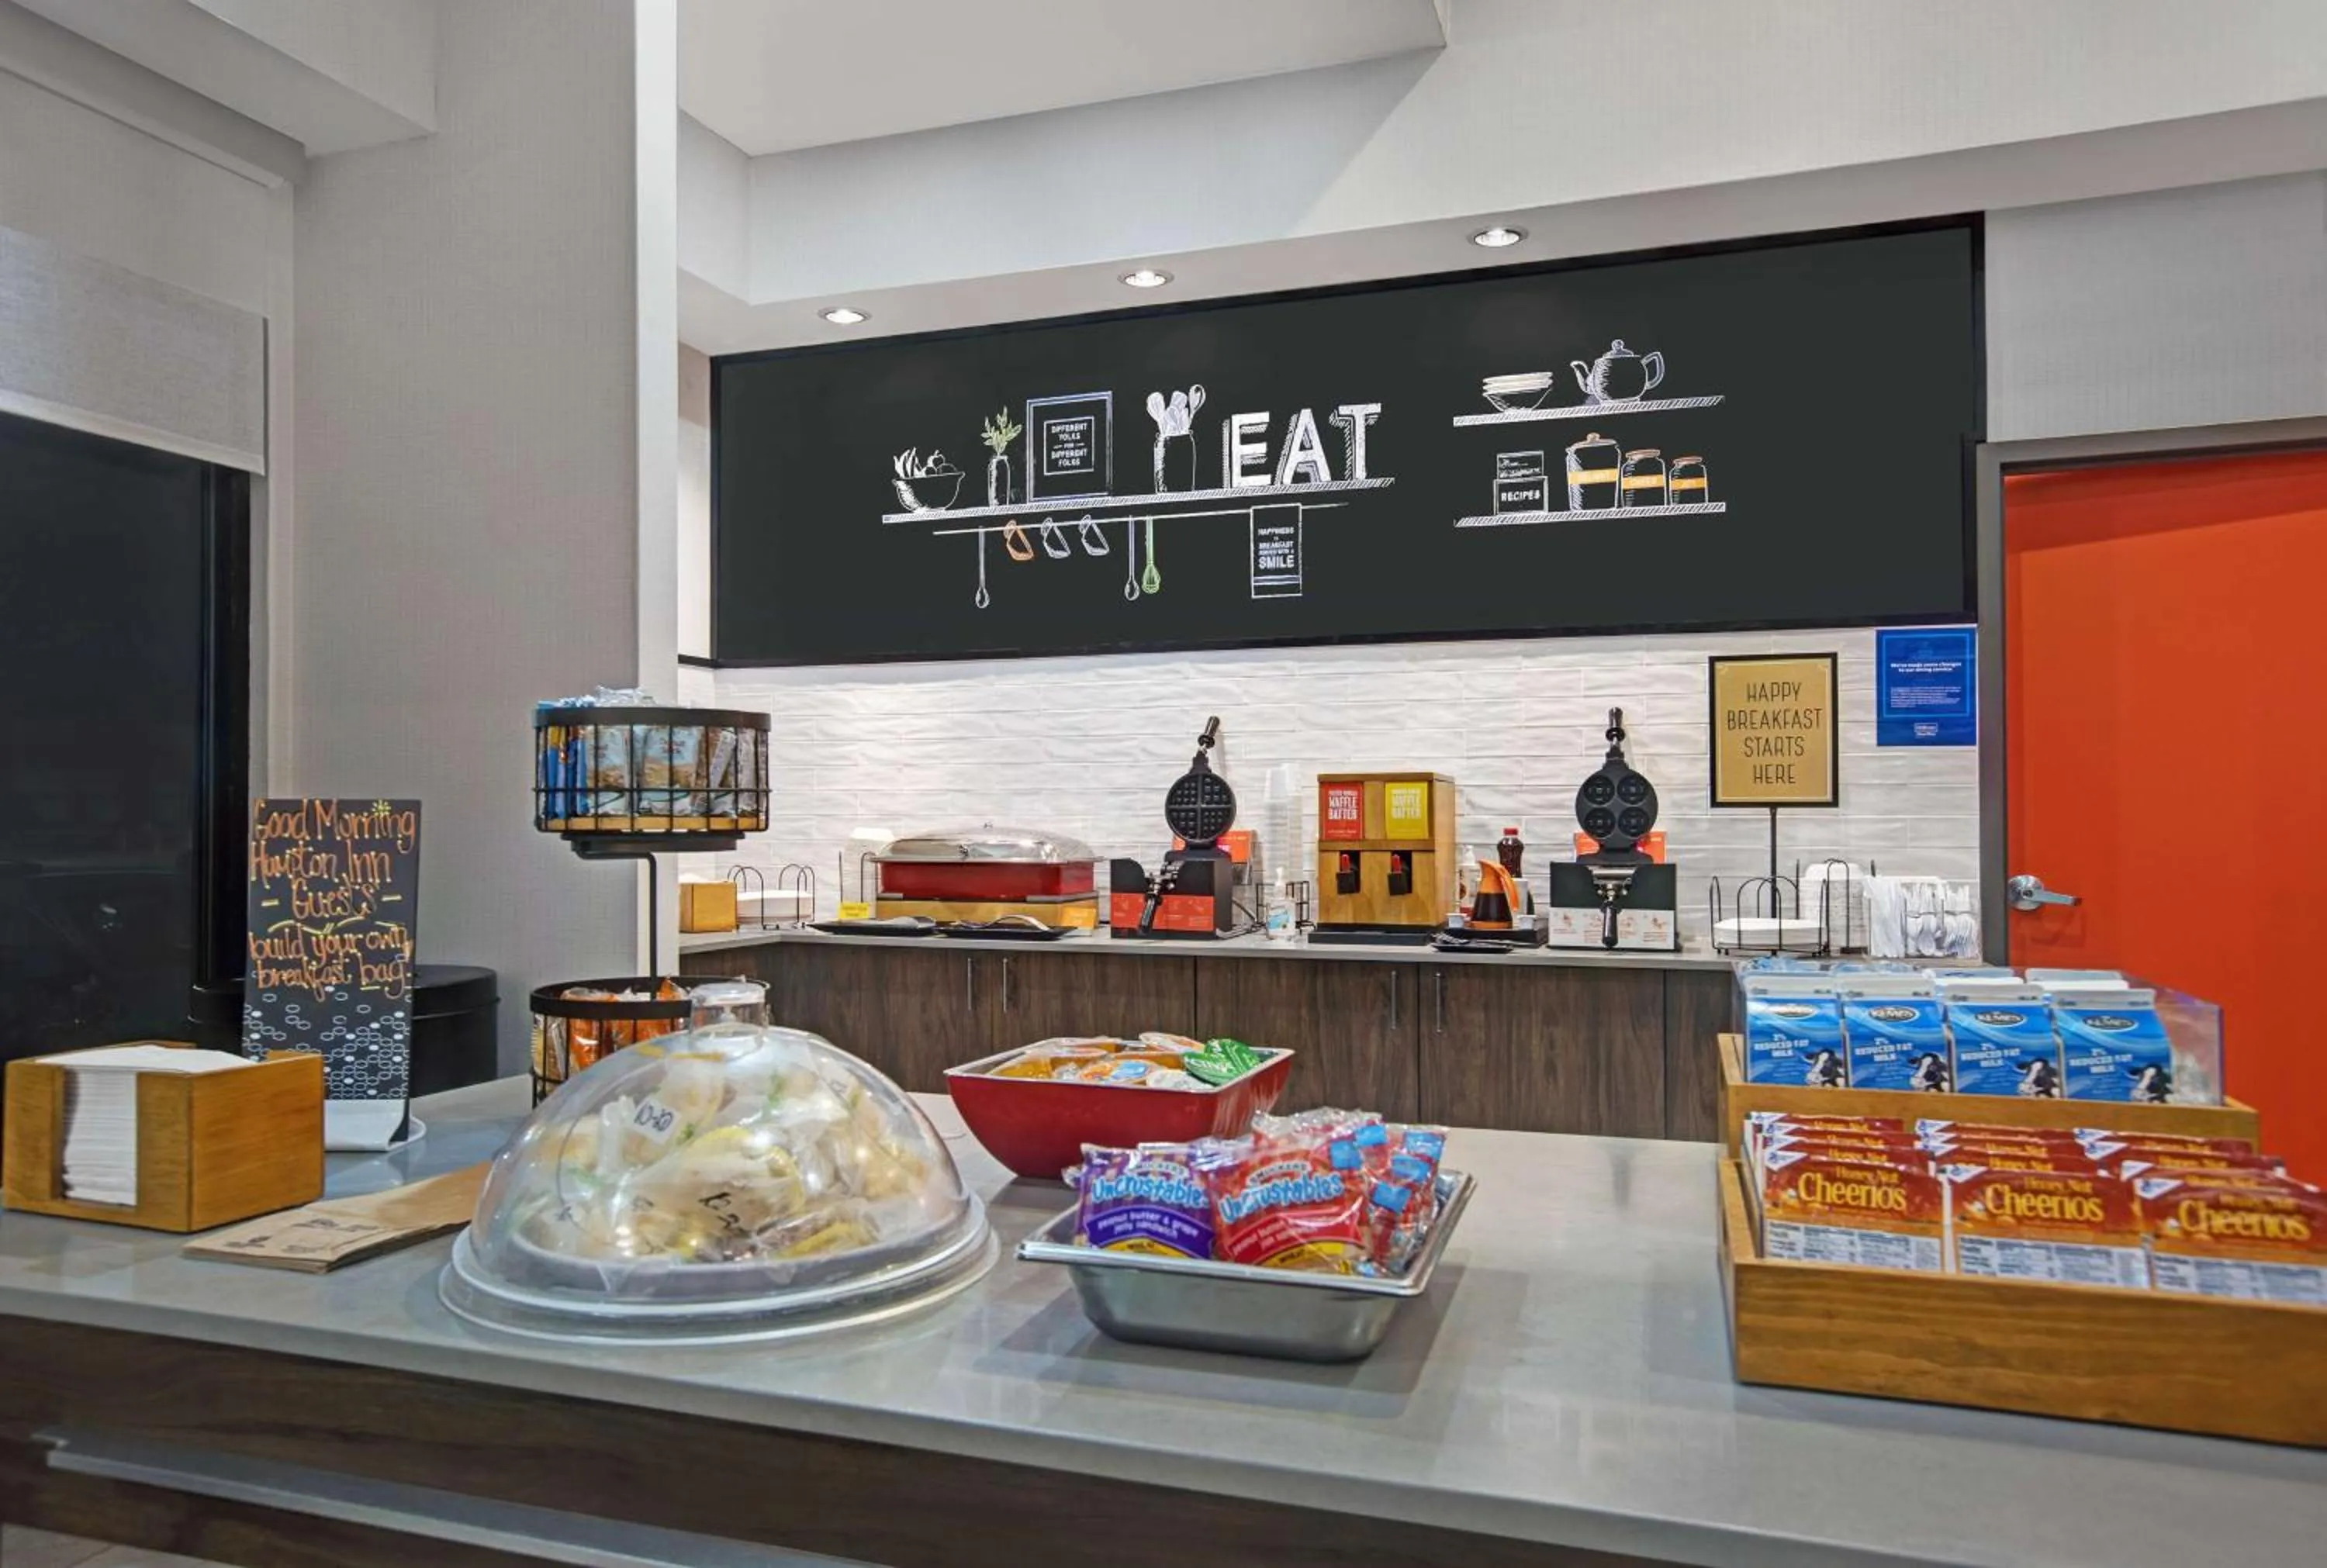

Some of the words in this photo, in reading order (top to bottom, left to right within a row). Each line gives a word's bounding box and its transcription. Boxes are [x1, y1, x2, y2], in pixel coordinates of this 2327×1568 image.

[1223, 403, 1381, 488] EAT
[1501, 489, 1541, 502] RECIPES
[1259, 555, 1295, 569] SMILE
[1747, 682, 1802, 703] HAPPY
[1727, 708, 1823, 730] BREAKFAST
[1744, 736, 1805, 758] STARTS
[1753, 764, 1796, 784] HERE
[1329, 796, 1357, 808] WAFFLE
[254, 797, 310, 840] Good
[313, 797, 415, 854] Morning
[250, 840, 340, 889] Hampton
[346, 839, 392, 883] Inn
[292, 872, 378, 919] Guests
[248, 922, 304, 960] build
[311, 933, 364, 969] your
[365, 925, 413, 952] own
[257, 953, 352, 1002] breakfast
[1799, 1173, 1907, 1211] Cheerios
[1876, 1169, 1899, 1184] Nut
[1219, 1172, 1344, 1224] Uncrustables
[1986, 1183, 2104, 1222] Cheerios
[2179, 1200, 2311, 1240] Cheerios
